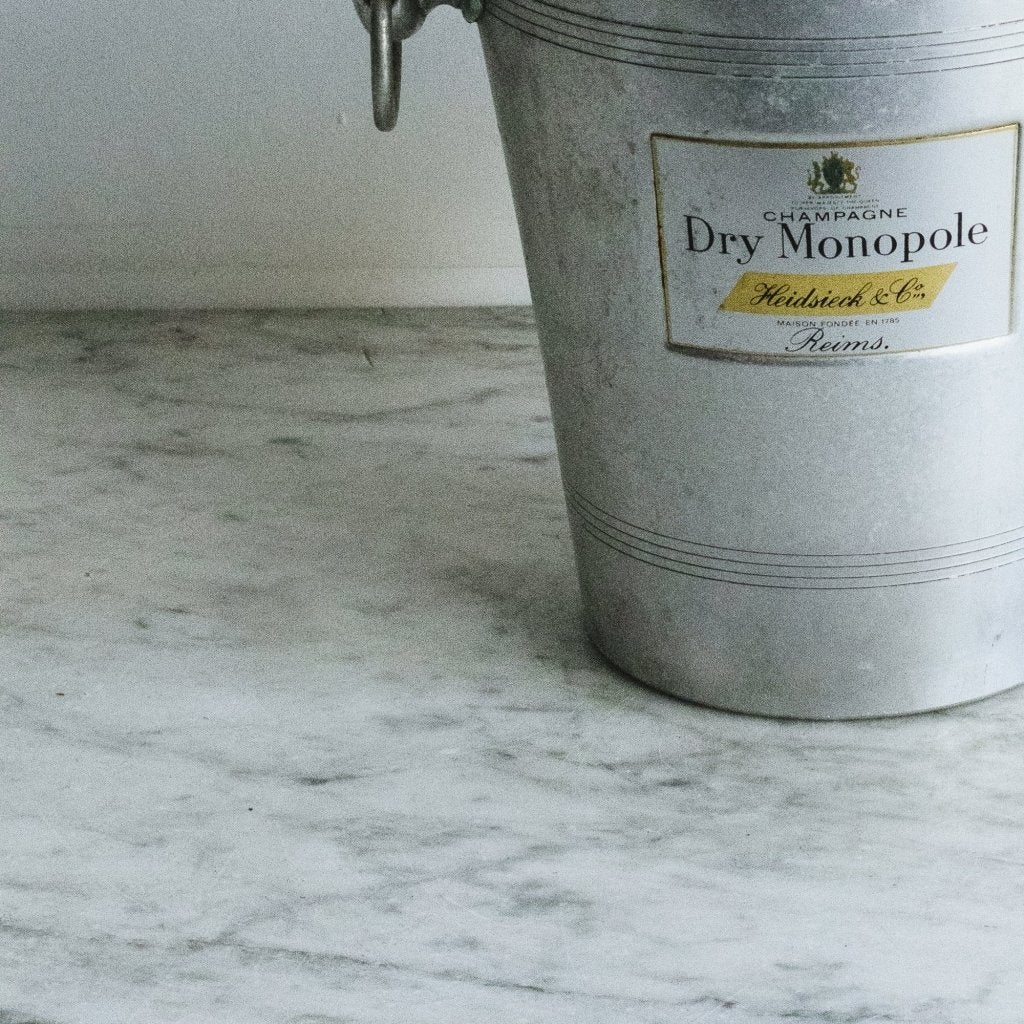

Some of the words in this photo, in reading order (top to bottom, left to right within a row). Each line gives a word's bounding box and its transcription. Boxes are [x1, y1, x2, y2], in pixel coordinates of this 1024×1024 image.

[763, 207, 908, 223] CHAMPAGNE
[684, 214, 764, 265] Dry
[777, 212, 988, 263] Monopole
[750, 281, 872, 308] Heidsieck
[870, 287, 889, 306] &
[785, 326, 889, 352] Reims.
